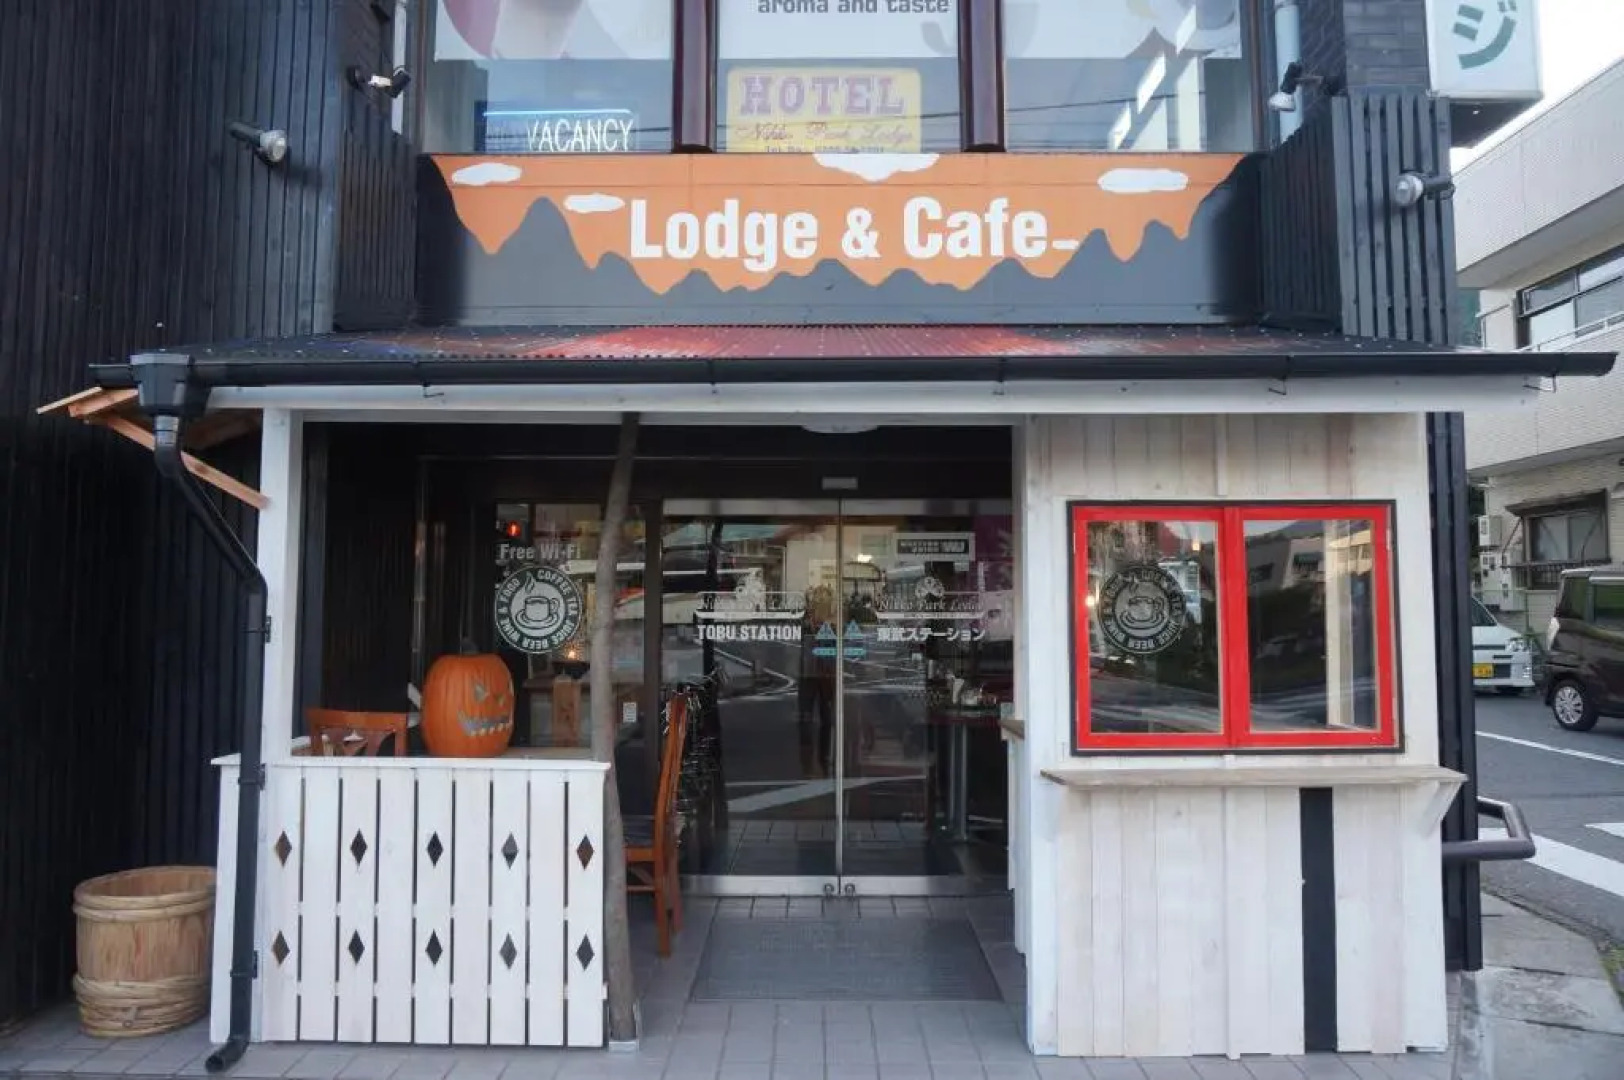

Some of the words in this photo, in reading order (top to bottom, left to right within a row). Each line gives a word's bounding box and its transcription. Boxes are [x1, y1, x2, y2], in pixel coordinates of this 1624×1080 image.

[757, 0, 828, 14] aroma
[838, 0, 878, 14] and
[887, 0, 951, 14] taste
[740, 75, 904, 115] HOTEL
[527, 118, 634, 152] VACANCY
[630, 198, 818, 272] Lodge
[842, 207, 881, 258] &
[499, 543, 534, 559] Free
[540, 543, 581, 559] Wi-Fi
[500, 578, 520, 602] FOOD
[537, 569, 572, 596] COFFEE
[567, 597, 579, 616] TEA
[500, 618, 521, 643] WINE
[551, 620, 575, 645] JUICE
[697, 624, 735, 640] TOBU
[740, 624, 802, 640] STATION
[877, 627, 986, 642] 東武ステーション
[522, 637, 549, 649] BEER
[1127, 638, 1155, 649] BEER
